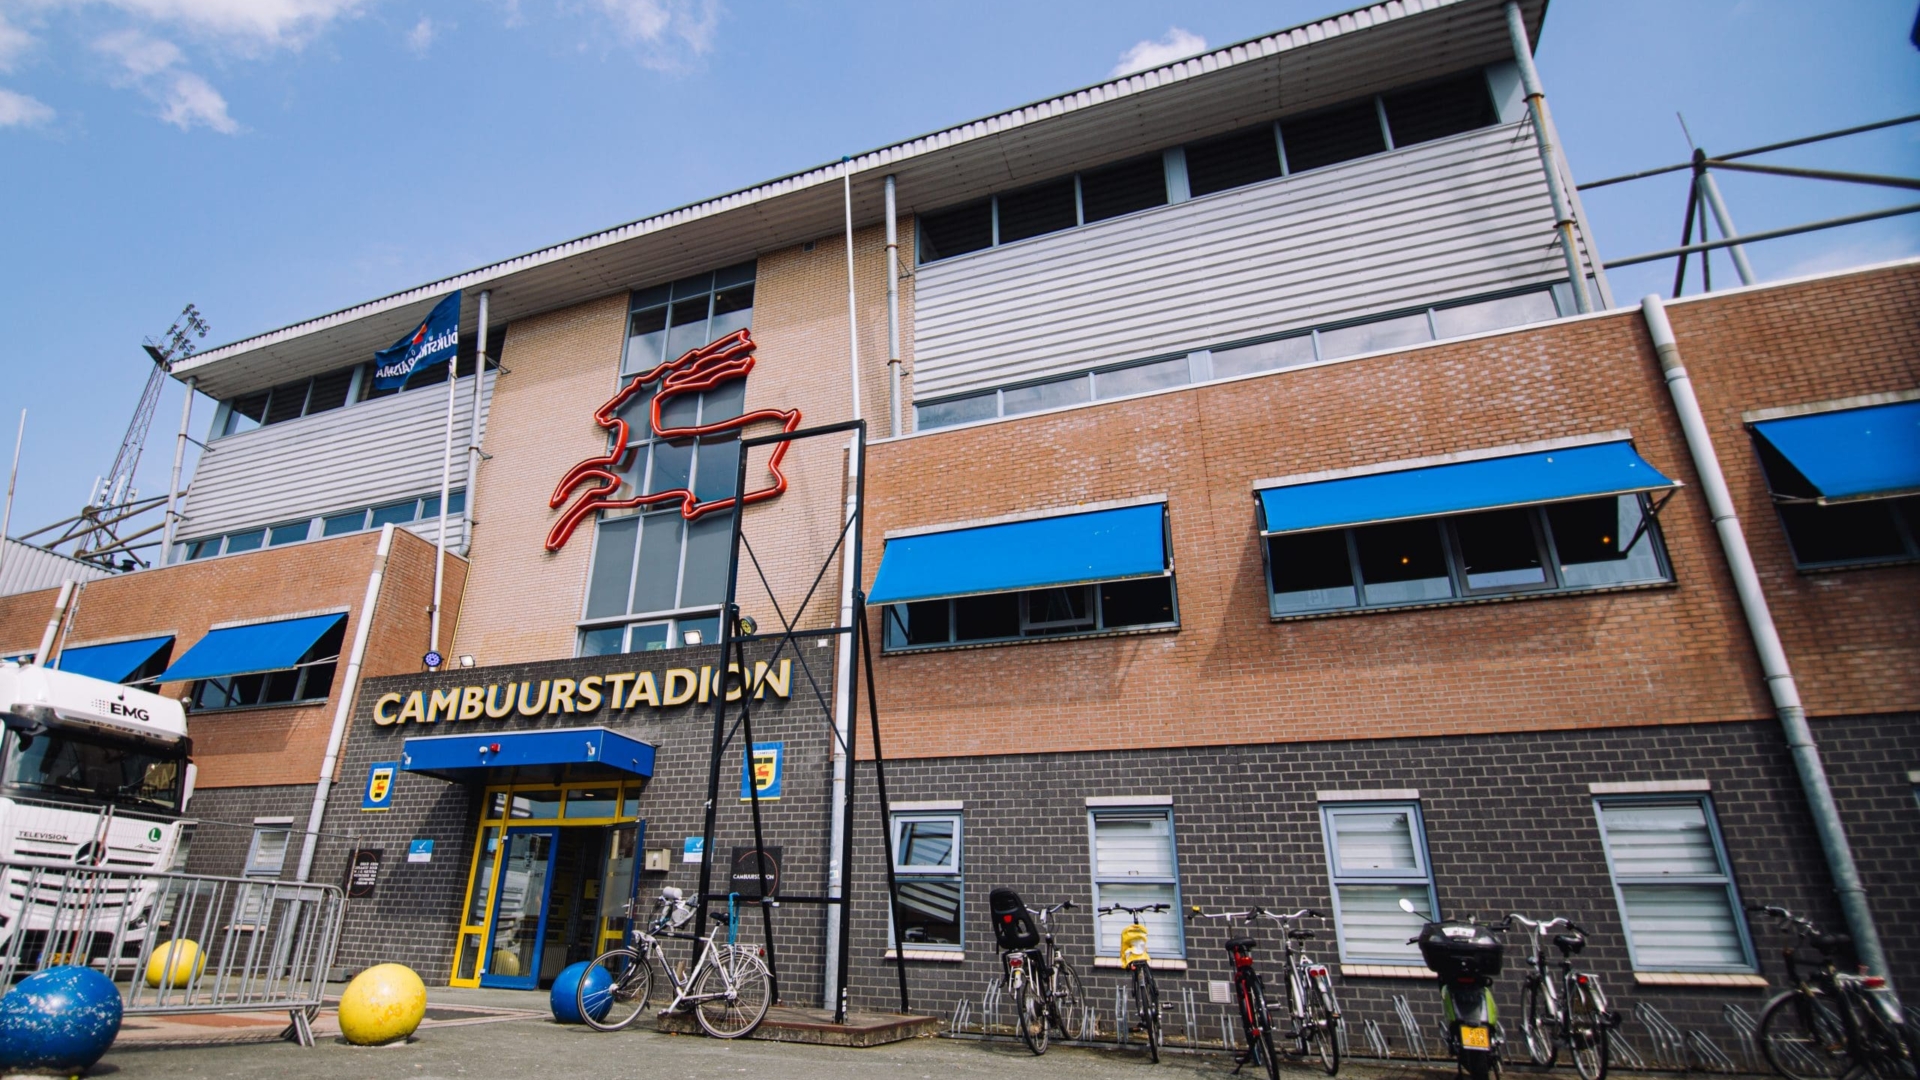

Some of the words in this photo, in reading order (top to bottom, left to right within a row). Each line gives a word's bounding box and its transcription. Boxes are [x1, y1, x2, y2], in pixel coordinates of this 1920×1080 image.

[372, 658, 794, 727] CAMBUURSTADION
[110, 702, 150, 722] EMG
[18, 830, 69, 841] TELEVISION
[151, 828, 158, 841] L
